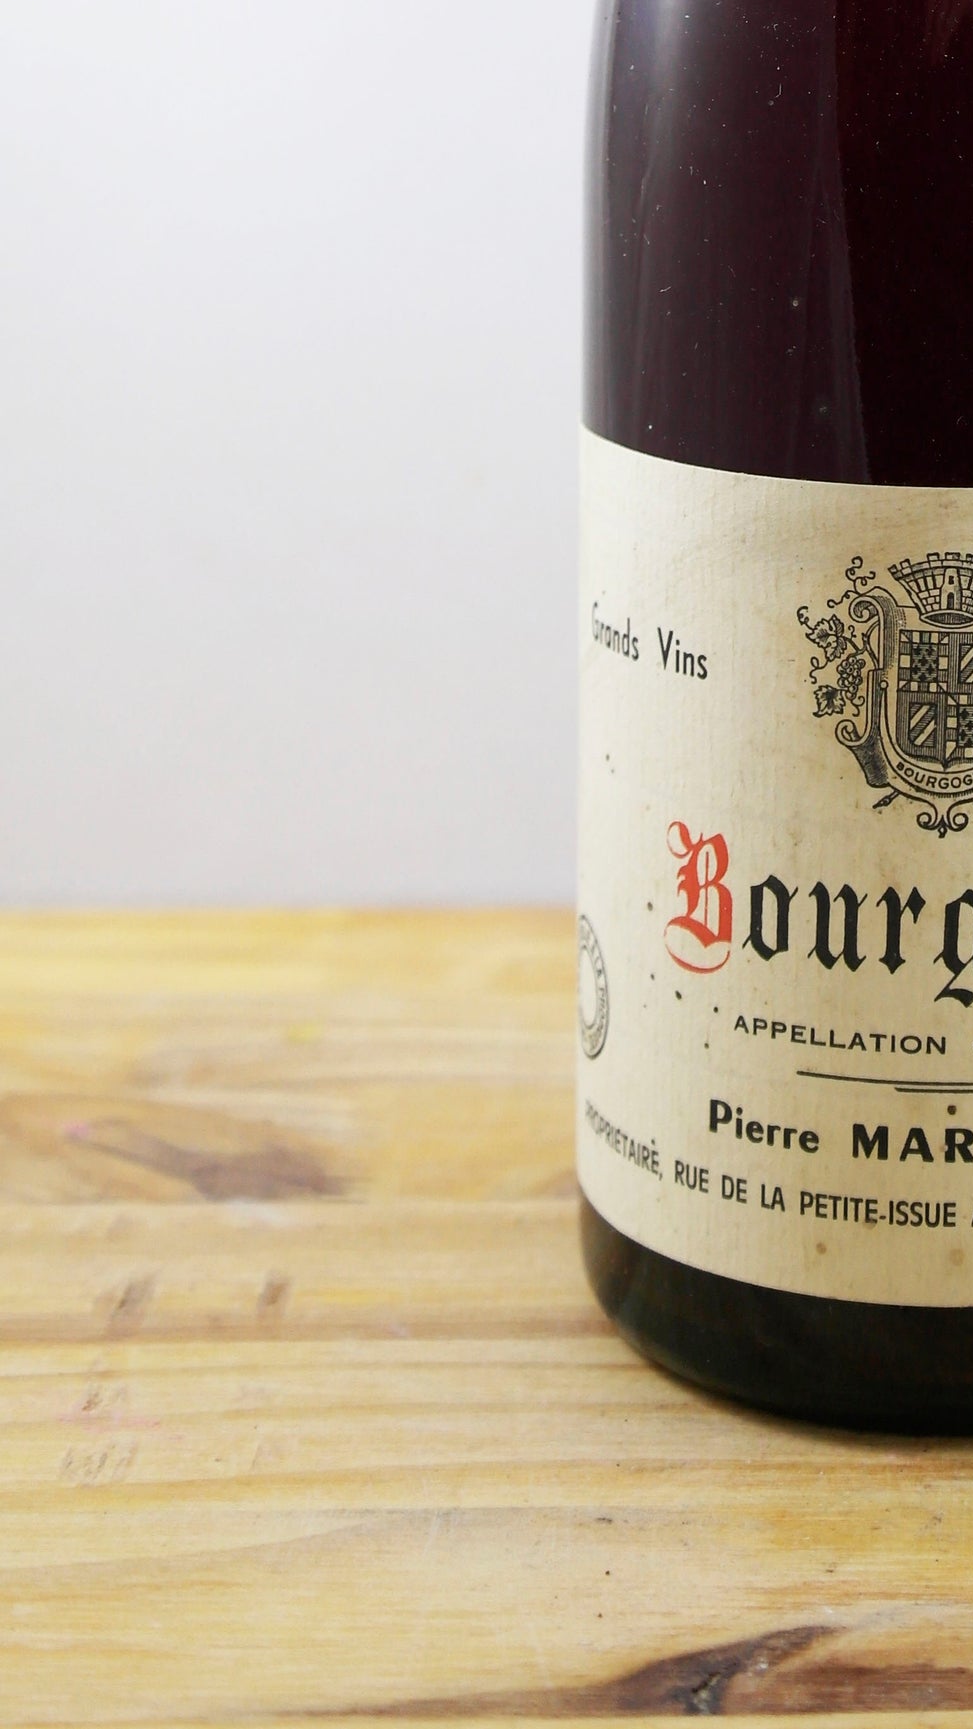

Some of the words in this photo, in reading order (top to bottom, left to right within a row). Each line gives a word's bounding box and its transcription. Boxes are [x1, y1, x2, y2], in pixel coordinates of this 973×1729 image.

[591, 600, 640, 662] Grands
[657, 626, 708, 680] Vins
[733, 1015, 947, 1055] APPELLATION
[708, 1099, 820, 1153] Pierre
[674, 1159, 709, 1194] RUE
[721, 1174, 748, 1204] DE
[760, 1183, 786, 1212] LA
[800, 1191, 957, 1228] PETITE-ISSUE
